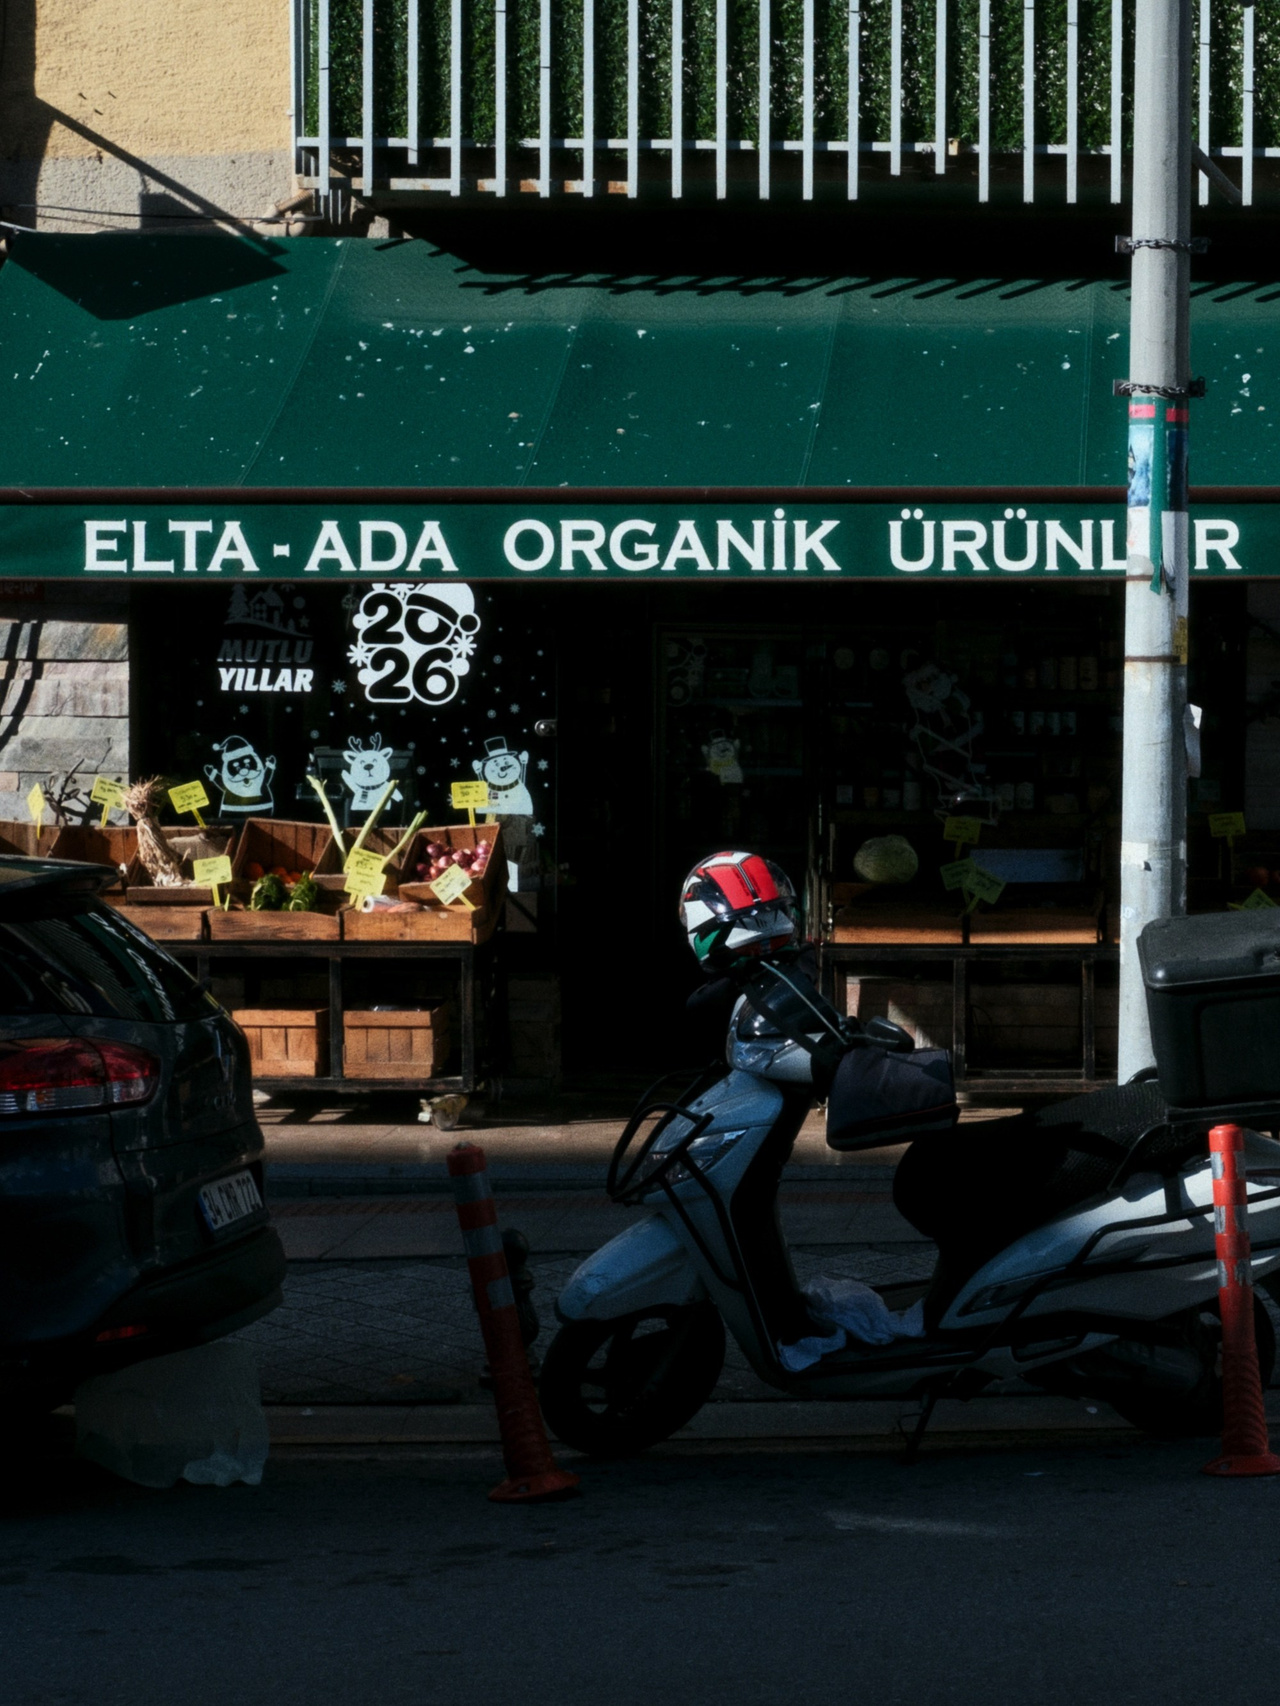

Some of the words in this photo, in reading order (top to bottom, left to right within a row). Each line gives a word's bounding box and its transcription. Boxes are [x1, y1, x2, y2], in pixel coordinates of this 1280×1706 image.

[84, 520, 259, 573] ELTA
[304, 520, 458, 572] ADA
[504, 511, 841, 572] ORGANİK
[889, 511, 1242, 572] ÜRÜNLR
[216, 638, 314, 663] MUTLU
[218, 667, 314, 692] YILLAR
[368, 646, 455, 702] 26
[202, 1190, 225, 1226] 34
